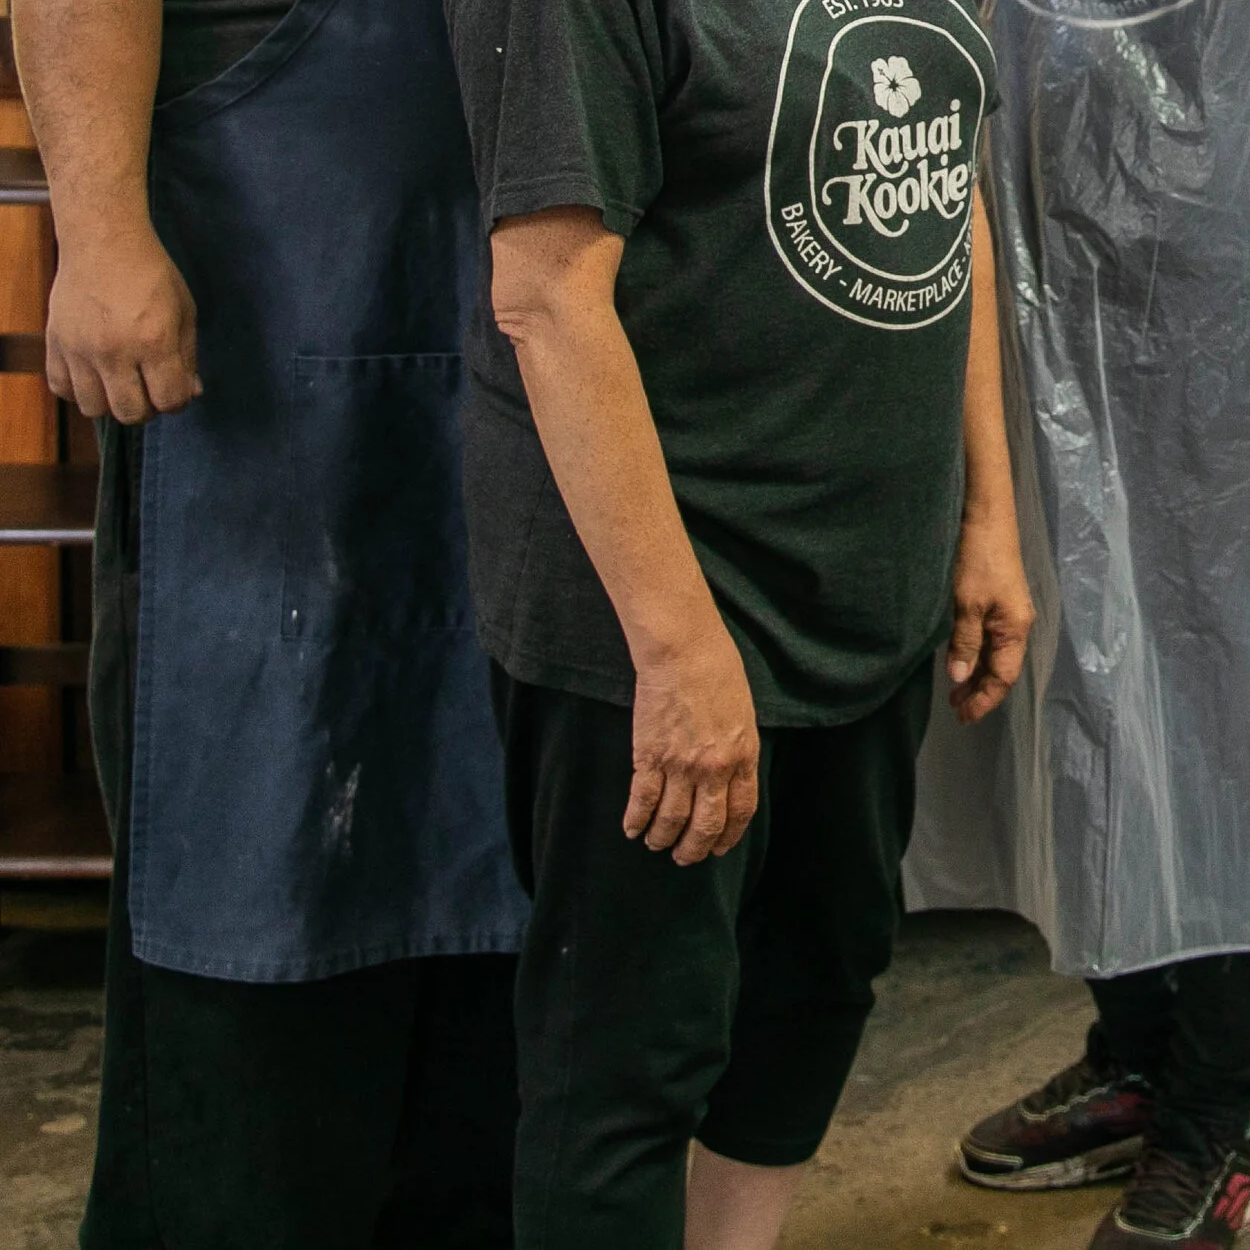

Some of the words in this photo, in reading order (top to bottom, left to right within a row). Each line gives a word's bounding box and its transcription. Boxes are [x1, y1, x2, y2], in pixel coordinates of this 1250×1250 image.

[833, 98, 963, 178] Kauai
[822, 154, 970, 237] Kookie
[781, 201, 840, 281] BAKERY
[849, 261, 964, 312] MARKETPLACE
